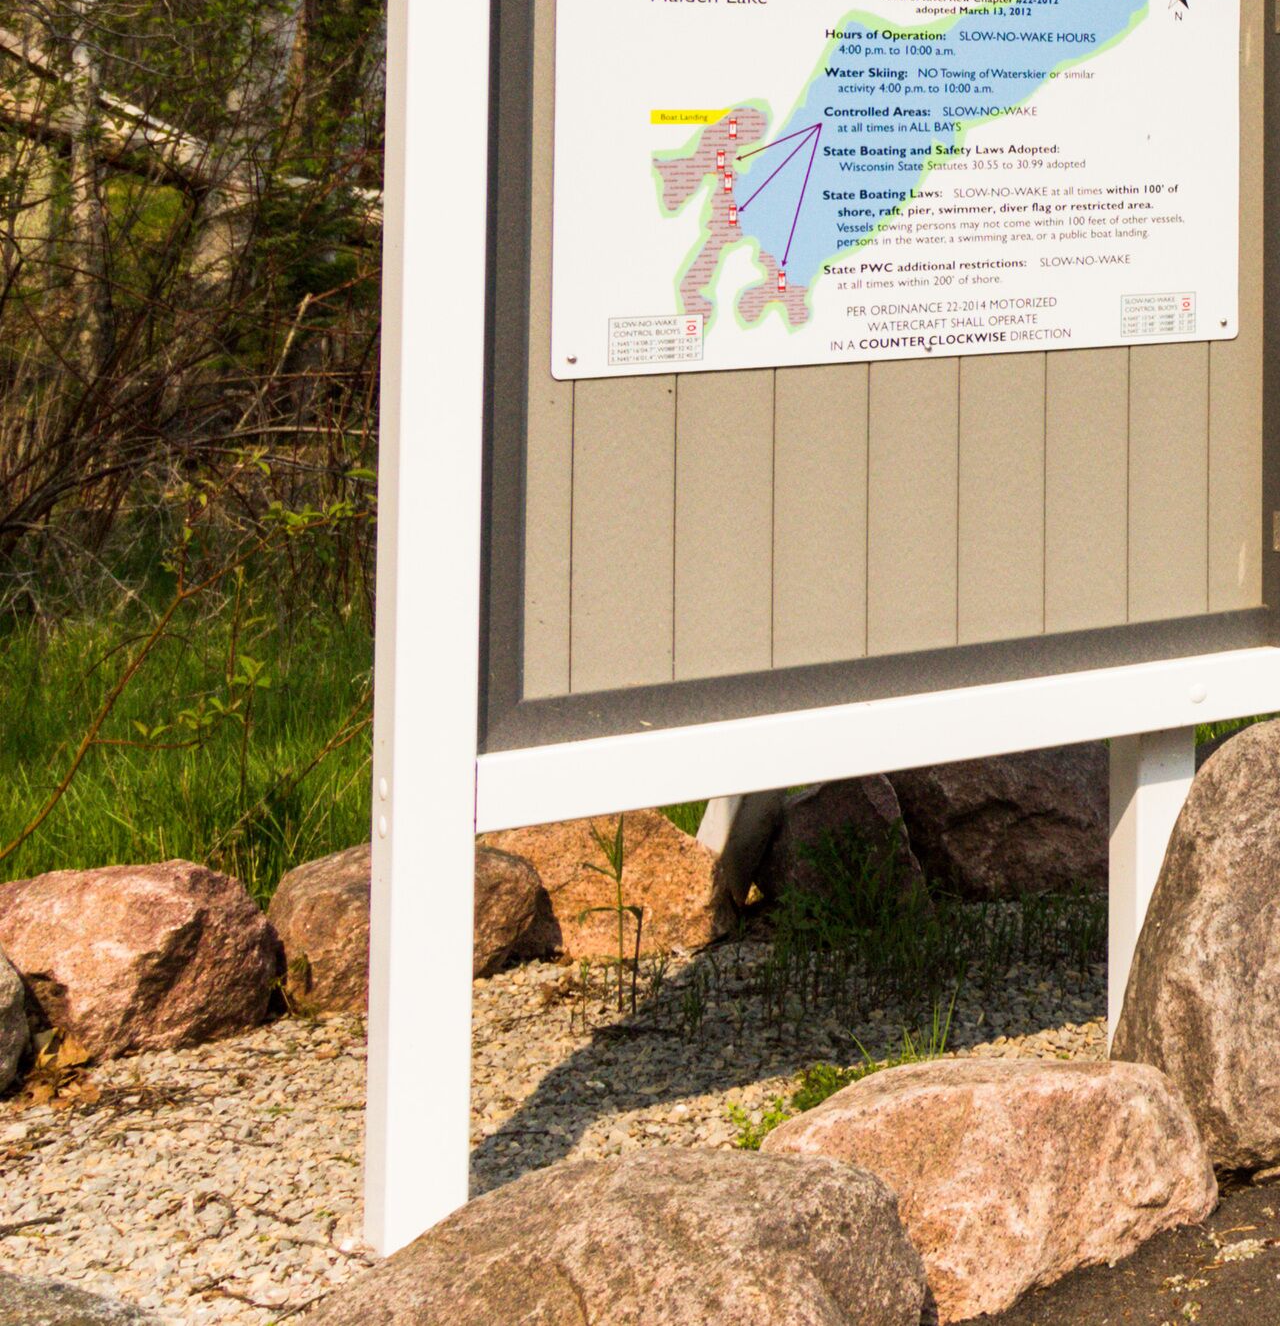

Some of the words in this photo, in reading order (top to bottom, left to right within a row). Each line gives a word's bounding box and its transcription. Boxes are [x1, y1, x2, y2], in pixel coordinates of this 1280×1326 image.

[915, 5, 956, 16] adopted
[959, 6, 989, 15] March
[993, 6, 1007, 17] 13,
[1009, 7, 1032, 16] 2012
[1174, 11, 1183, 21] N
[825, 29, 863, 40] Hours
[865, 29, 879, 40] of
[881, 29, 946, 43] Operation:
[959, 30, 1053, 42] SLOW-NO-WAKE
[1056, 32, 1096, 43] HOURS
[838, 44, 862, 55] 4:00
[864, 47, 887, 58] p.m.
[888, 47, 901, 55] to
[905, 44, 933, 56] 10:00
[935, 48, 956, 56] a.m.
[824, 67, 865, 78] Water
[868, 67, 908, 81] Skiing:
[917, 68, 939, 78] NO
[940, 68, 976, 81] Towing
[979, 68, 990, 79] of
[990, 68, 1046, 79] Waterskier
[1064, 70, 1094, 79] similar
[660, 113, 678, 121] Boat
[679, 113, 708, 122] Landing
[823, 106, 889, 117] Controlled
[892, 106, 931, 117] Areas:
[942, 106, 1036, 117] SLOW-NO-WAKE
[823, 146, 856, 157] State
[860, 145, 907, 159] Boating
[910, 145, 932, 156] and
[935, 144, 972, 157] Safety
[975, 145, 1004, 154] Laws
[1008, 144, 1059, 156] Adopted:
[822, 190, 856, 201] State
[859, 188, 906, 202] Boating
[909, 188, 943, 199] Laws:
[953, 186, 1047, 198] SLOW-NO-WAKE
[1051, 188, 1060, 196] at
[1063, 187, 1073, 195] all
[1106, 185, 1139, 195] within
[1144, 184, 1165, 194] 100'
[1167, 184, 1179, 193] of
[837, 206, 875, 218] shore,
[878, 205, 904, 217] raft,
[907, 205, 934, 218] pier,
[938, 204, 996, 215] swimmer,
[999, 203, 1028, 213] diver
[1031, 202, 1052, 214] flag
[1054, 204, 1067, 212] or
[1070, 200, 1124, 211] restricted
[823, 264, 856, 275] State
[860, 262, 893, 273] PWC
[897, 260, 956, 272] additional
[959, 258, 1027, 270] restrictions:
[1040, 254, 1130, 267] SLOW-NO-WAKE
[846, 305, 867, 317] PER
[870, 301, 943, 316] ORDINANCE
[946, 300, 986, 312] 22-2014
[989, 296, 1057, 310] MOTORIZED
[867, 318, 948, 332] WATERCRAFT
[950, 316, 985, 329] SHALL
[987, 313, 1038, 326] OPERATE
[830, 341, 843, 350] IN
[847, 340, 855, 349] A
[859, 336, 925, 349] COUNTER
[928, 331, 1006, 345] CLOCKWISE
[1010, 328, 1071, 340] DIRECTION
